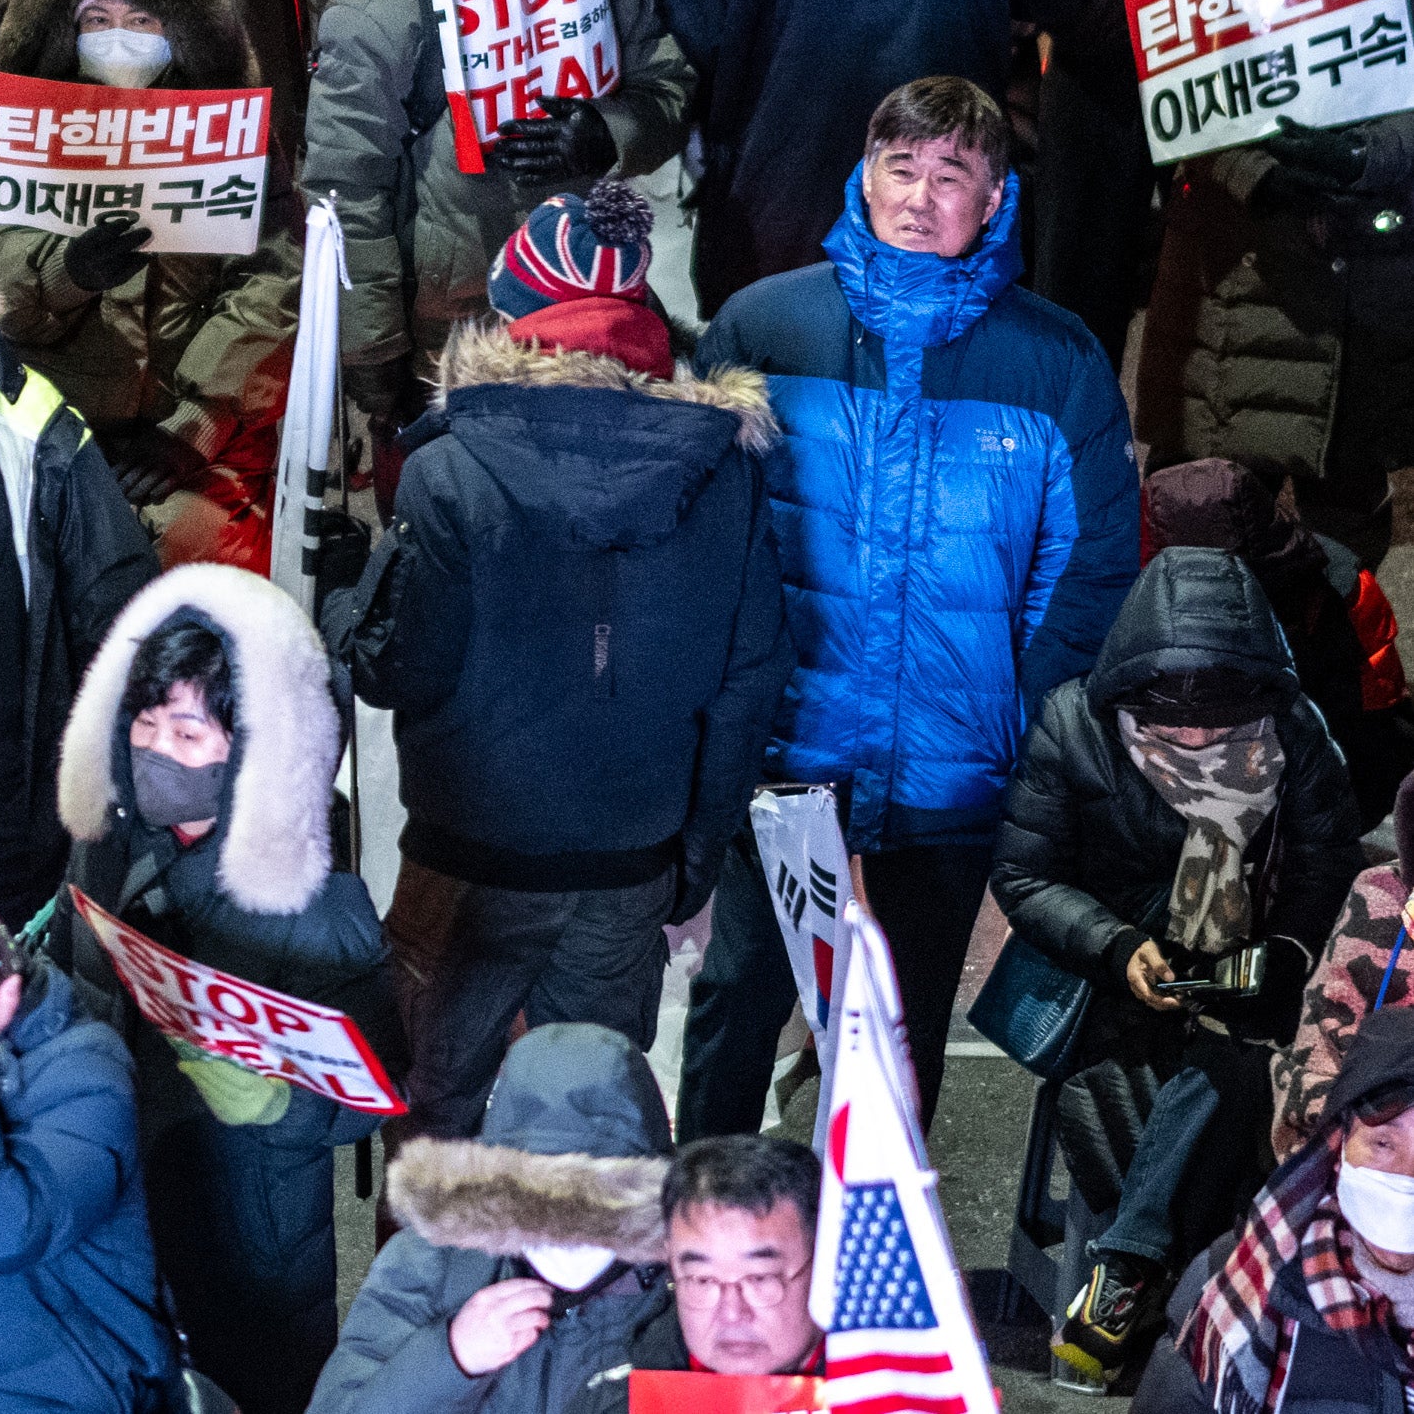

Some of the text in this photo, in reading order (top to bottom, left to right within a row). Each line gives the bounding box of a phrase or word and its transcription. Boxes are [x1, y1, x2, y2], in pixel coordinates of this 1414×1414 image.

[488, 18, 560, 72] THE
[1150, 13, 1408, 142] 이재명 구속
[151, 173, 258, 223] 구속
